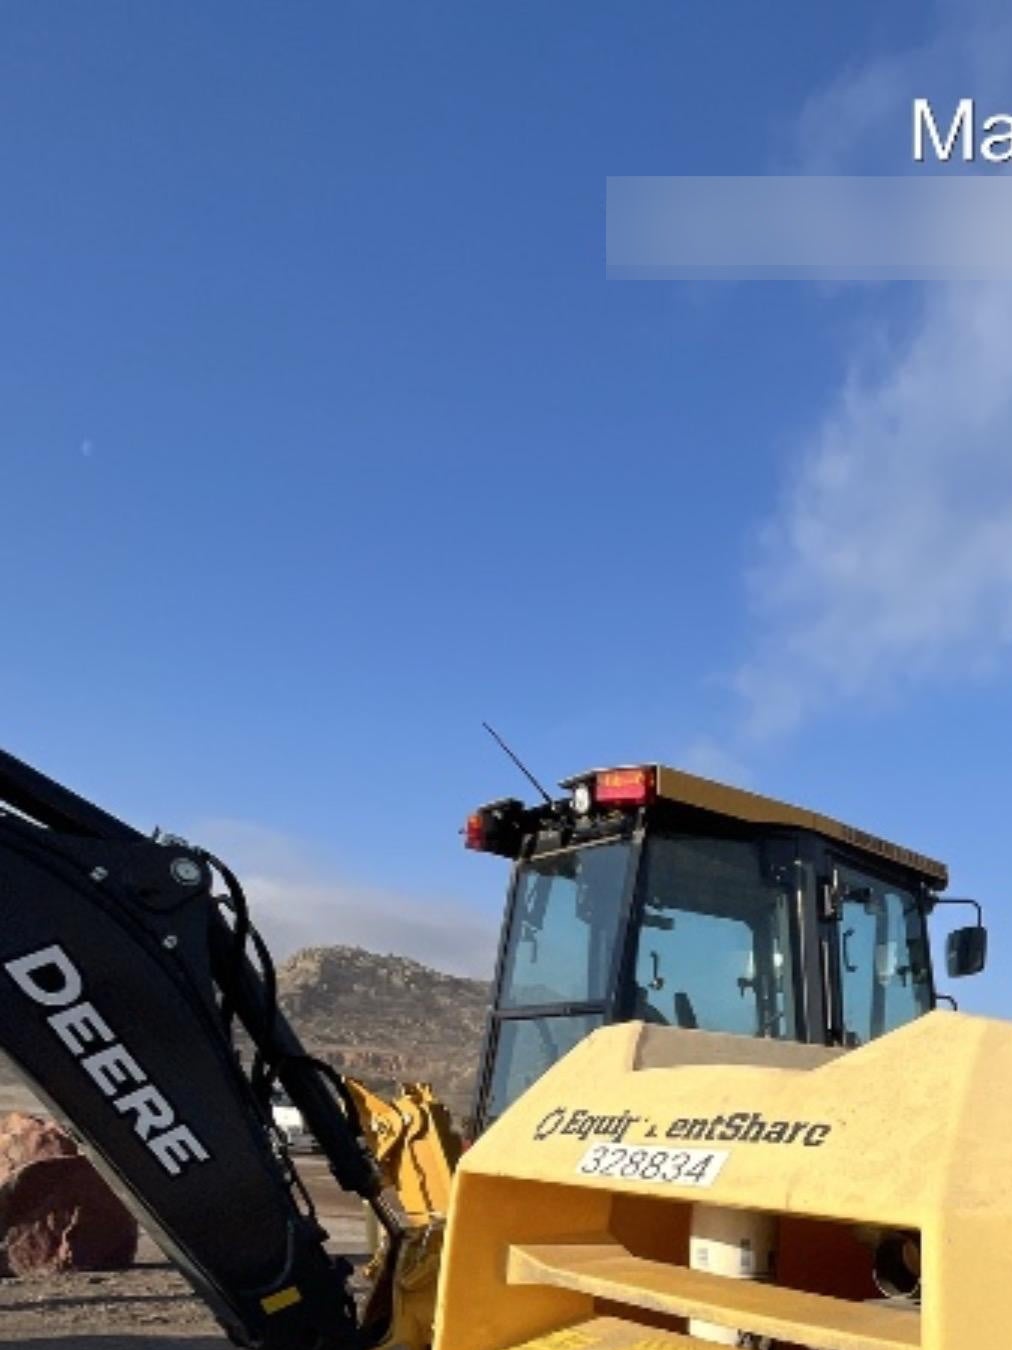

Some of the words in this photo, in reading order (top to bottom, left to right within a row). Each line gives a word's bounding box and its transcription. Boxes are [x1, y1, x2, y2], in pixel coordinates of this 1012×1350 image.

[4, 943, 212, 1175] DEERE
[559, 1108, 832, 1148] EquipentShare
[579, 1145, 717, 1185] 328834
